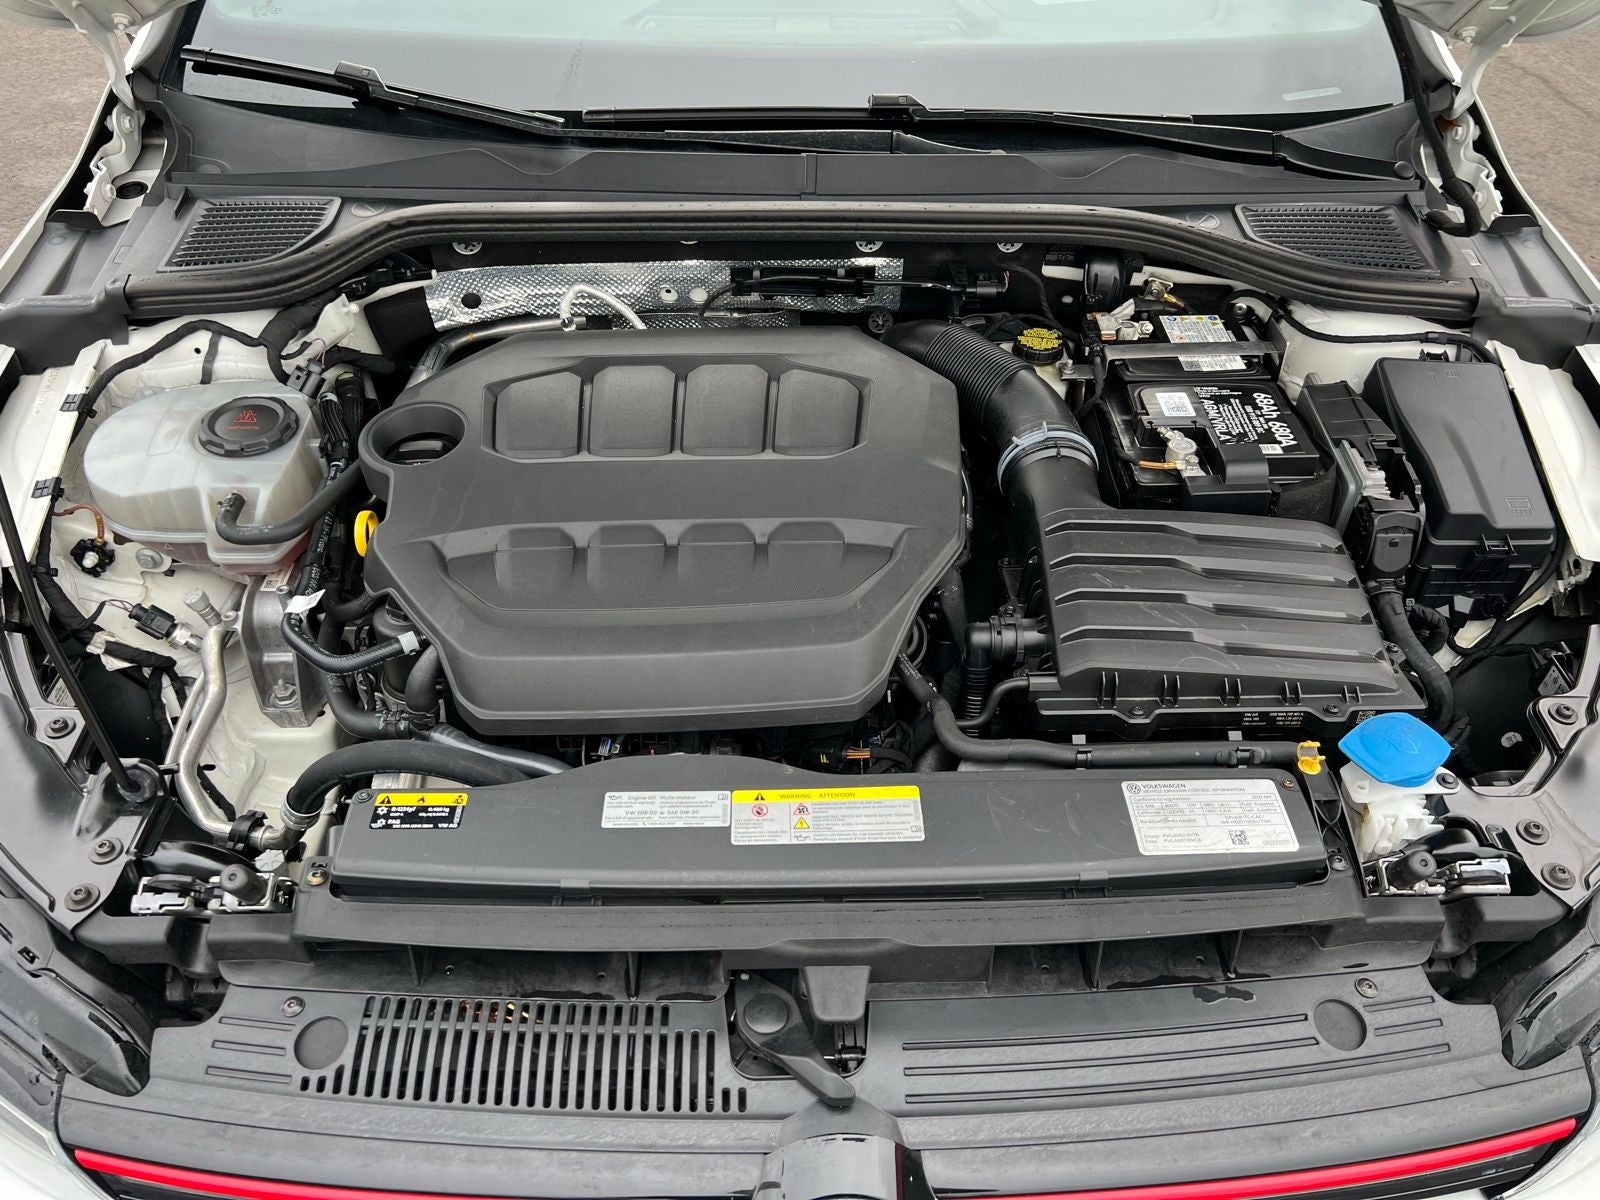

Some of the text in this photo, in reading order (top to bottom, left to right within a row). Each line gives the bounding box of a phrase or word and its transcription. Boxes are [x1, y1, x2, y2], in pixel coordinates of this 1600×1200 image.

[1200, 399, 1232, 441] AGM/VRLA
[1253, 392, 1281, 419] 68Ah
[1268, 421, 1298, 447] 680A
